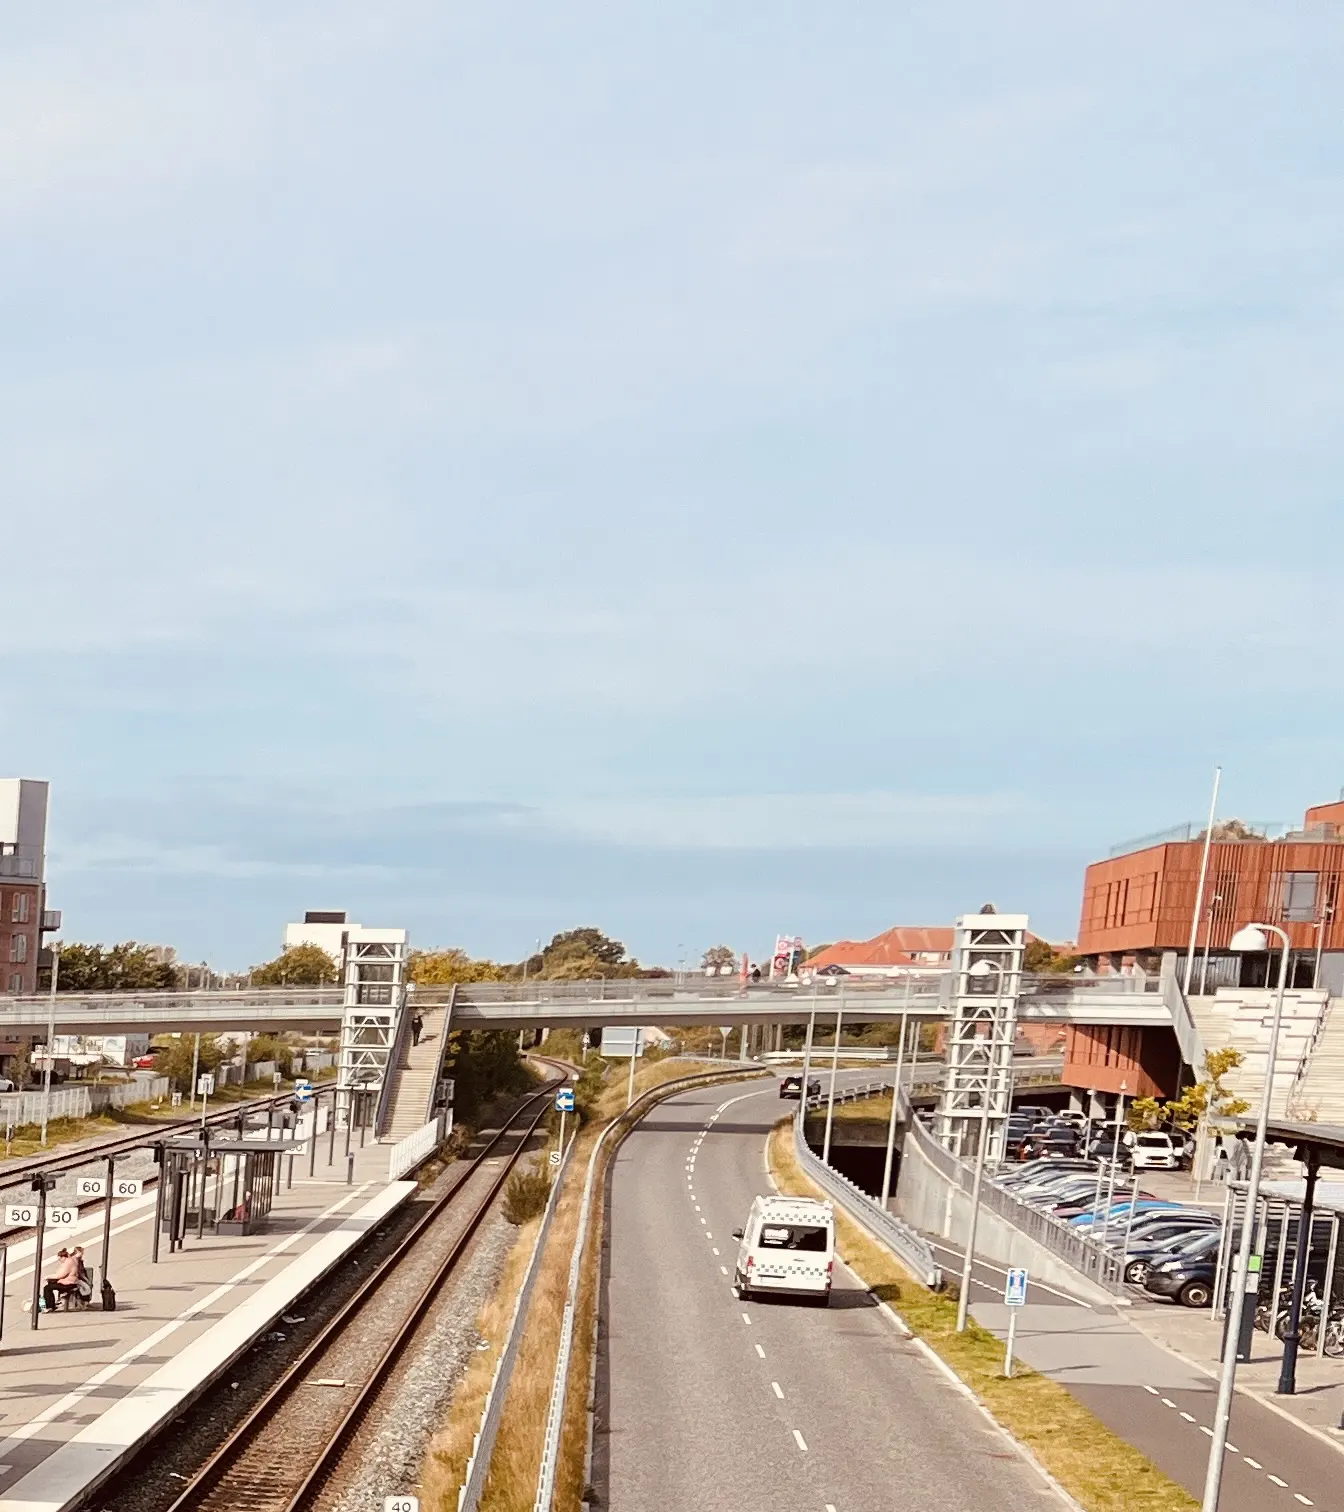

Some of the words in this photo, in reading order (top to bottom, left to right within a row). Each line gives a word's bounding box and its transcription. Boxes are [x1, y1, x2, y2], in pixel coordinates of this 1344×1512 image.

[550, 1153, 560, 1163] S
[82, 1181, 101, 1193] 60
[118, 1183, 137, 1194] 60
[11, 1209, 31, 1222] 50
[52, 1211, 72, 1223] 50
[391, 1502, 412, 1512] 40
